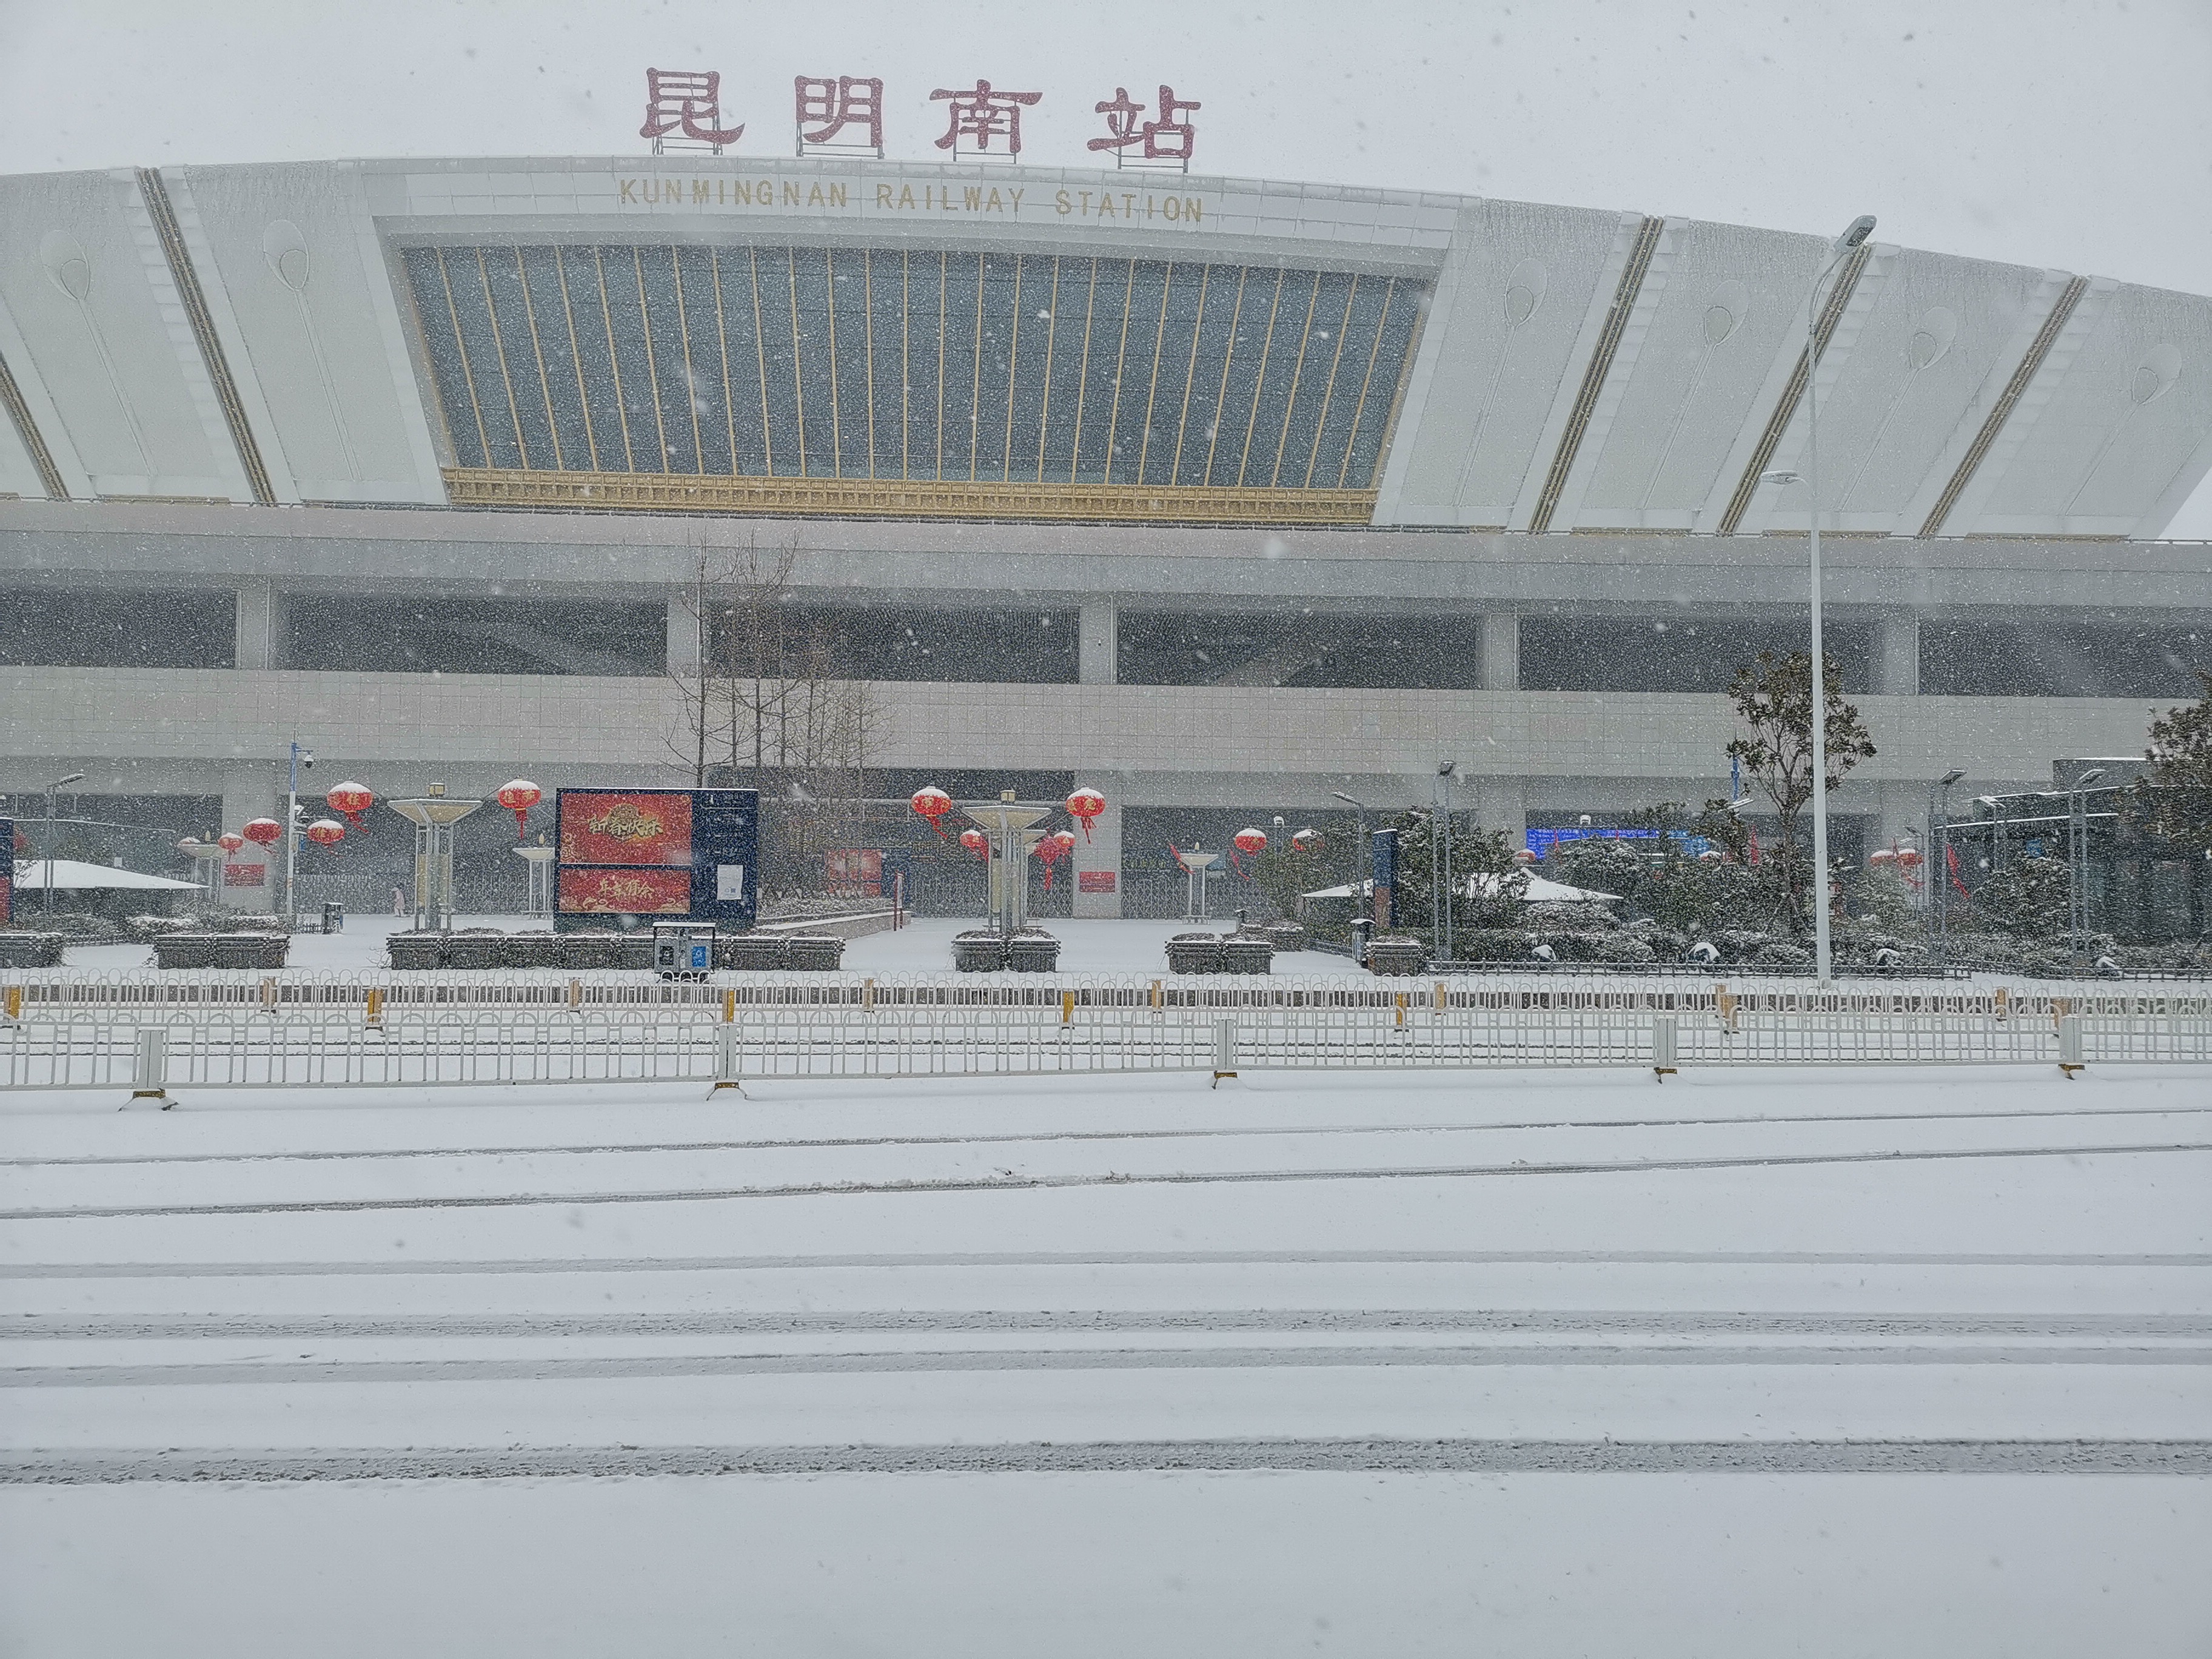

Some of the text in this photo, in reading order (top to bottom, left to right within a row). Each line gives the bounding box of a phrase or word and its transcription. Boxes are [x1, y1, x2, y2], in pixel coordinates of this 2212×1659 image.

[639, 67, 1202, 159] 昆明南站
[620, 179, 1202, 222] KUNMINGNAN RAILWAY STATION
[588, 814, 663, 836] 新春快乐
